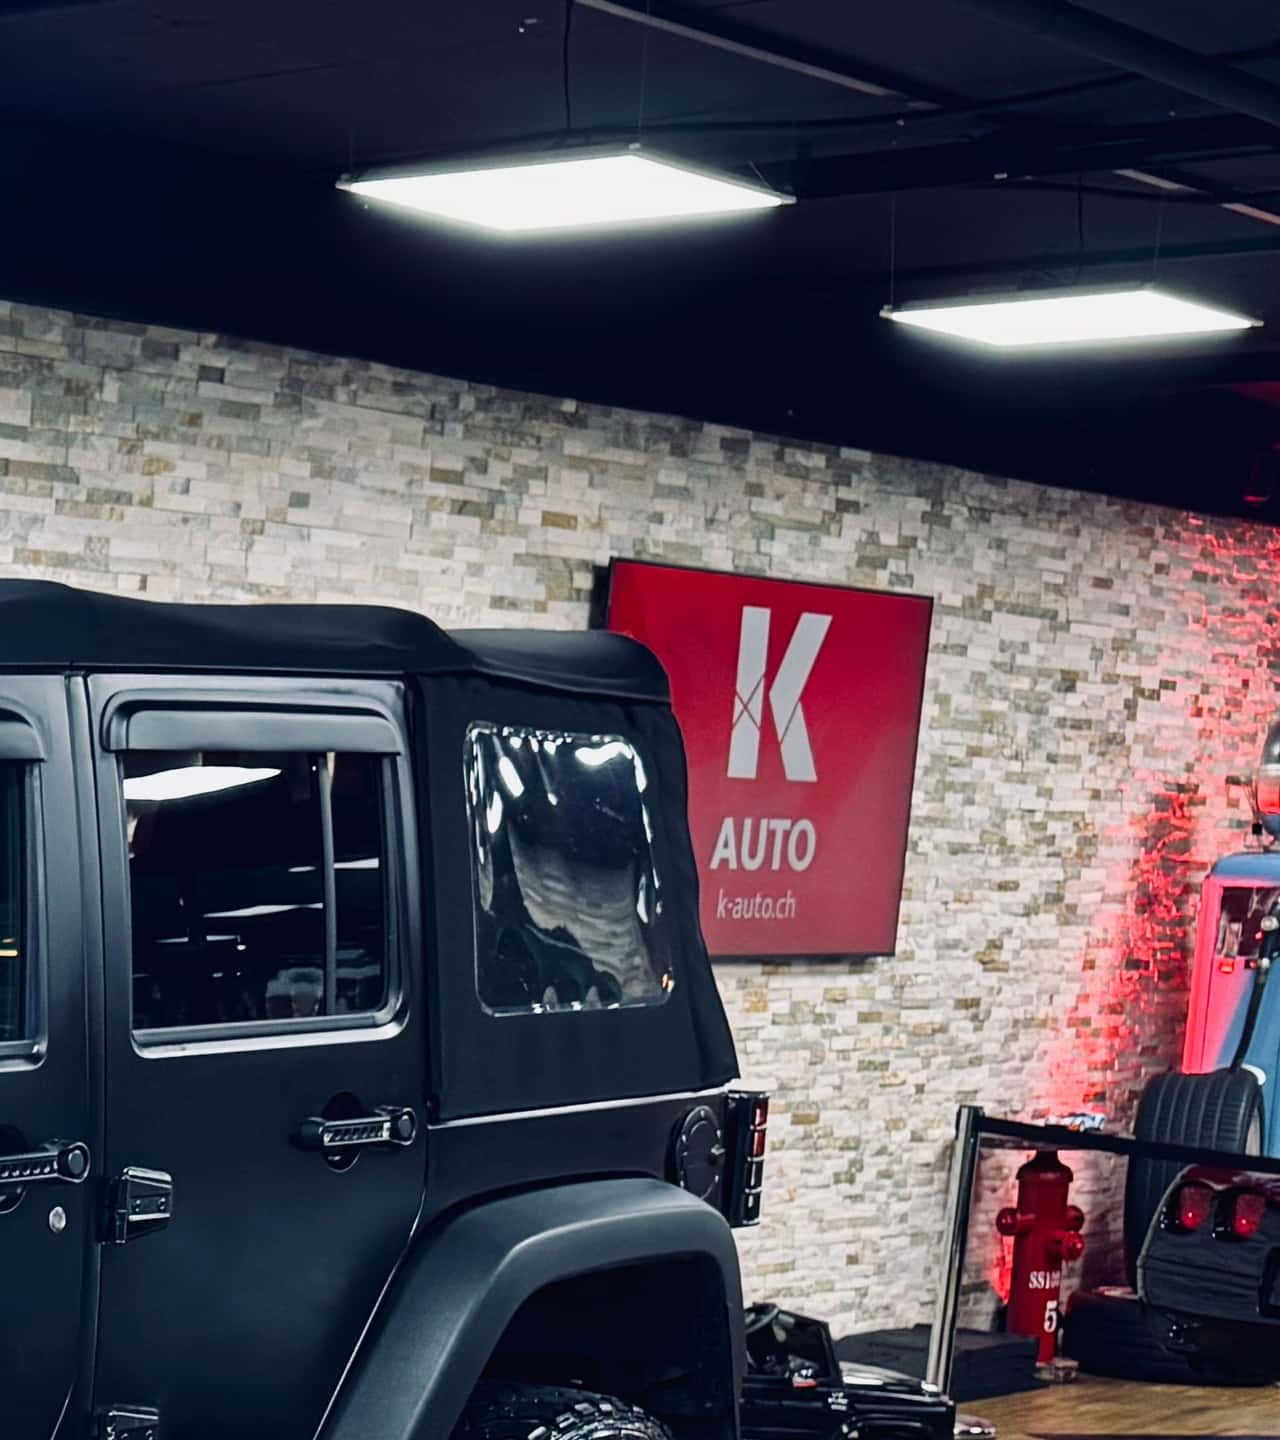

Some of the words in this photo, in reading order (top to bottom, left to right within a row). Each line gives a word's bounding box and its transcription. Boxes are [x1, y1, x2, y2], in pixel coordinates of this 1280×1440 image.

[727, 605, 833, 783] K
[710, 816, 817, 872] AUTO
[716, 889, 797, 920] k-auto.ch
[1043, 1300, 1058, 1334] 5
